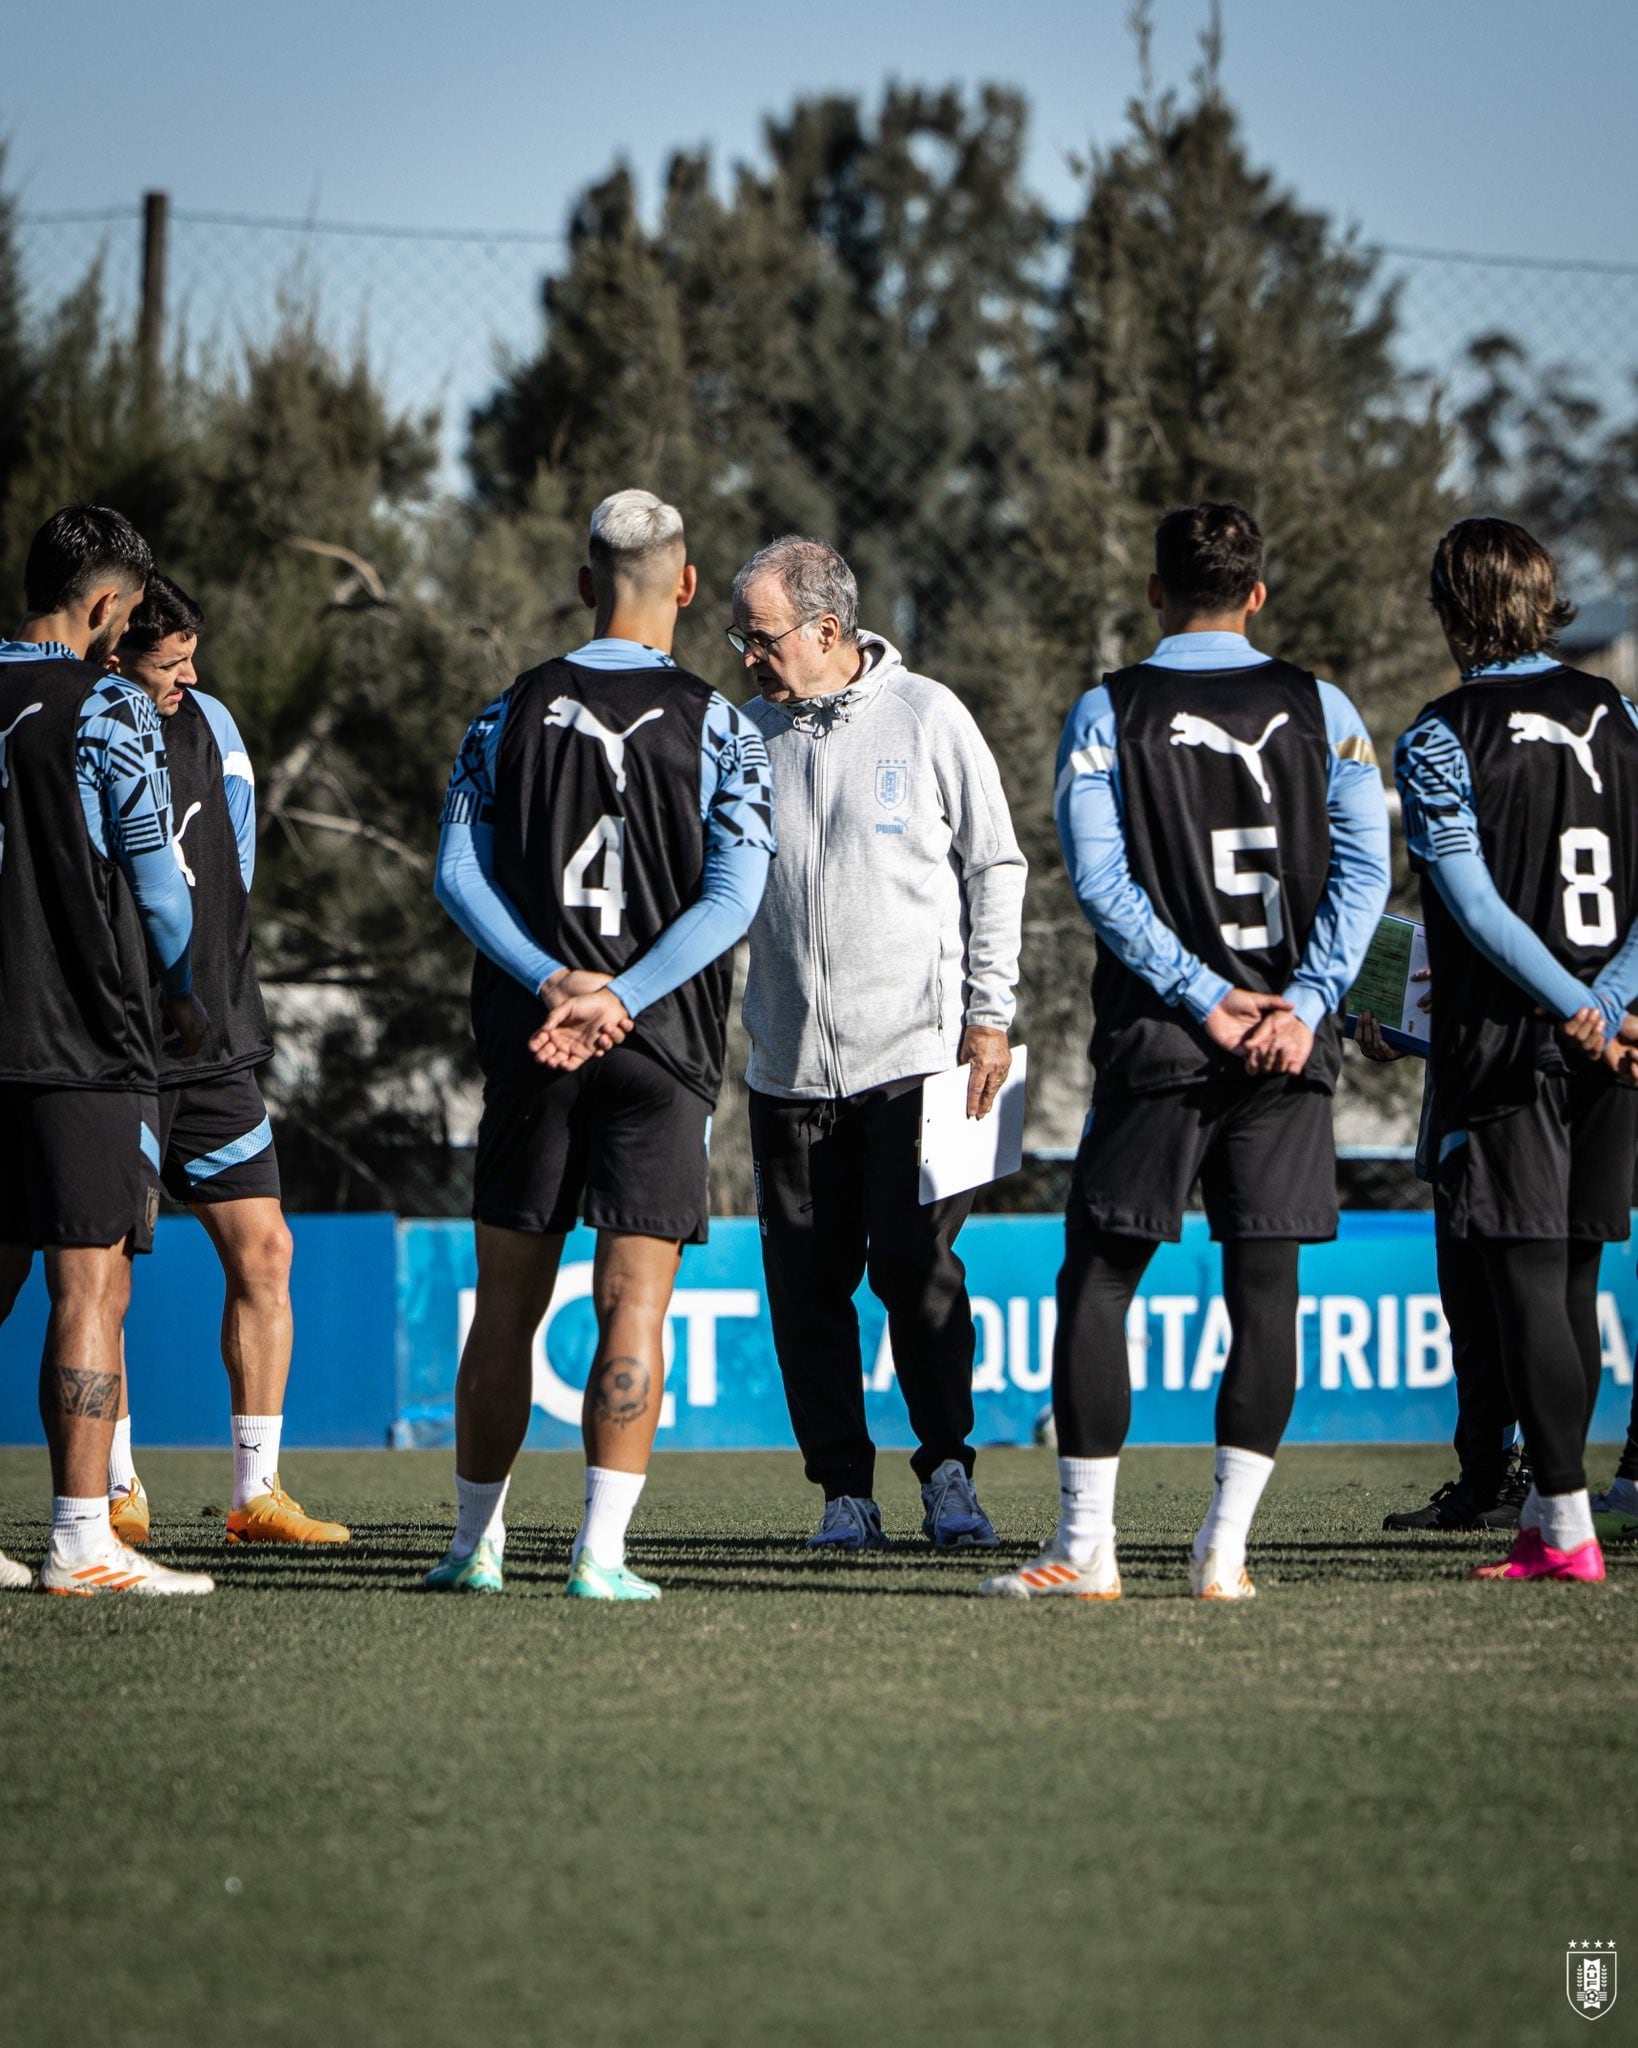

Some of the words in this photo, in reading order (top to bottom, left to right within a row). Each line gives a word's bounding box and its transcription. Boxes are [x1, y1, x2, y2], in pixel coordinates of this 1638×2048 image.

[564, 814, 628, 936] 4
[1211, 826, 1284, 951] 5
[1560, 827, 1617, 947] 8
